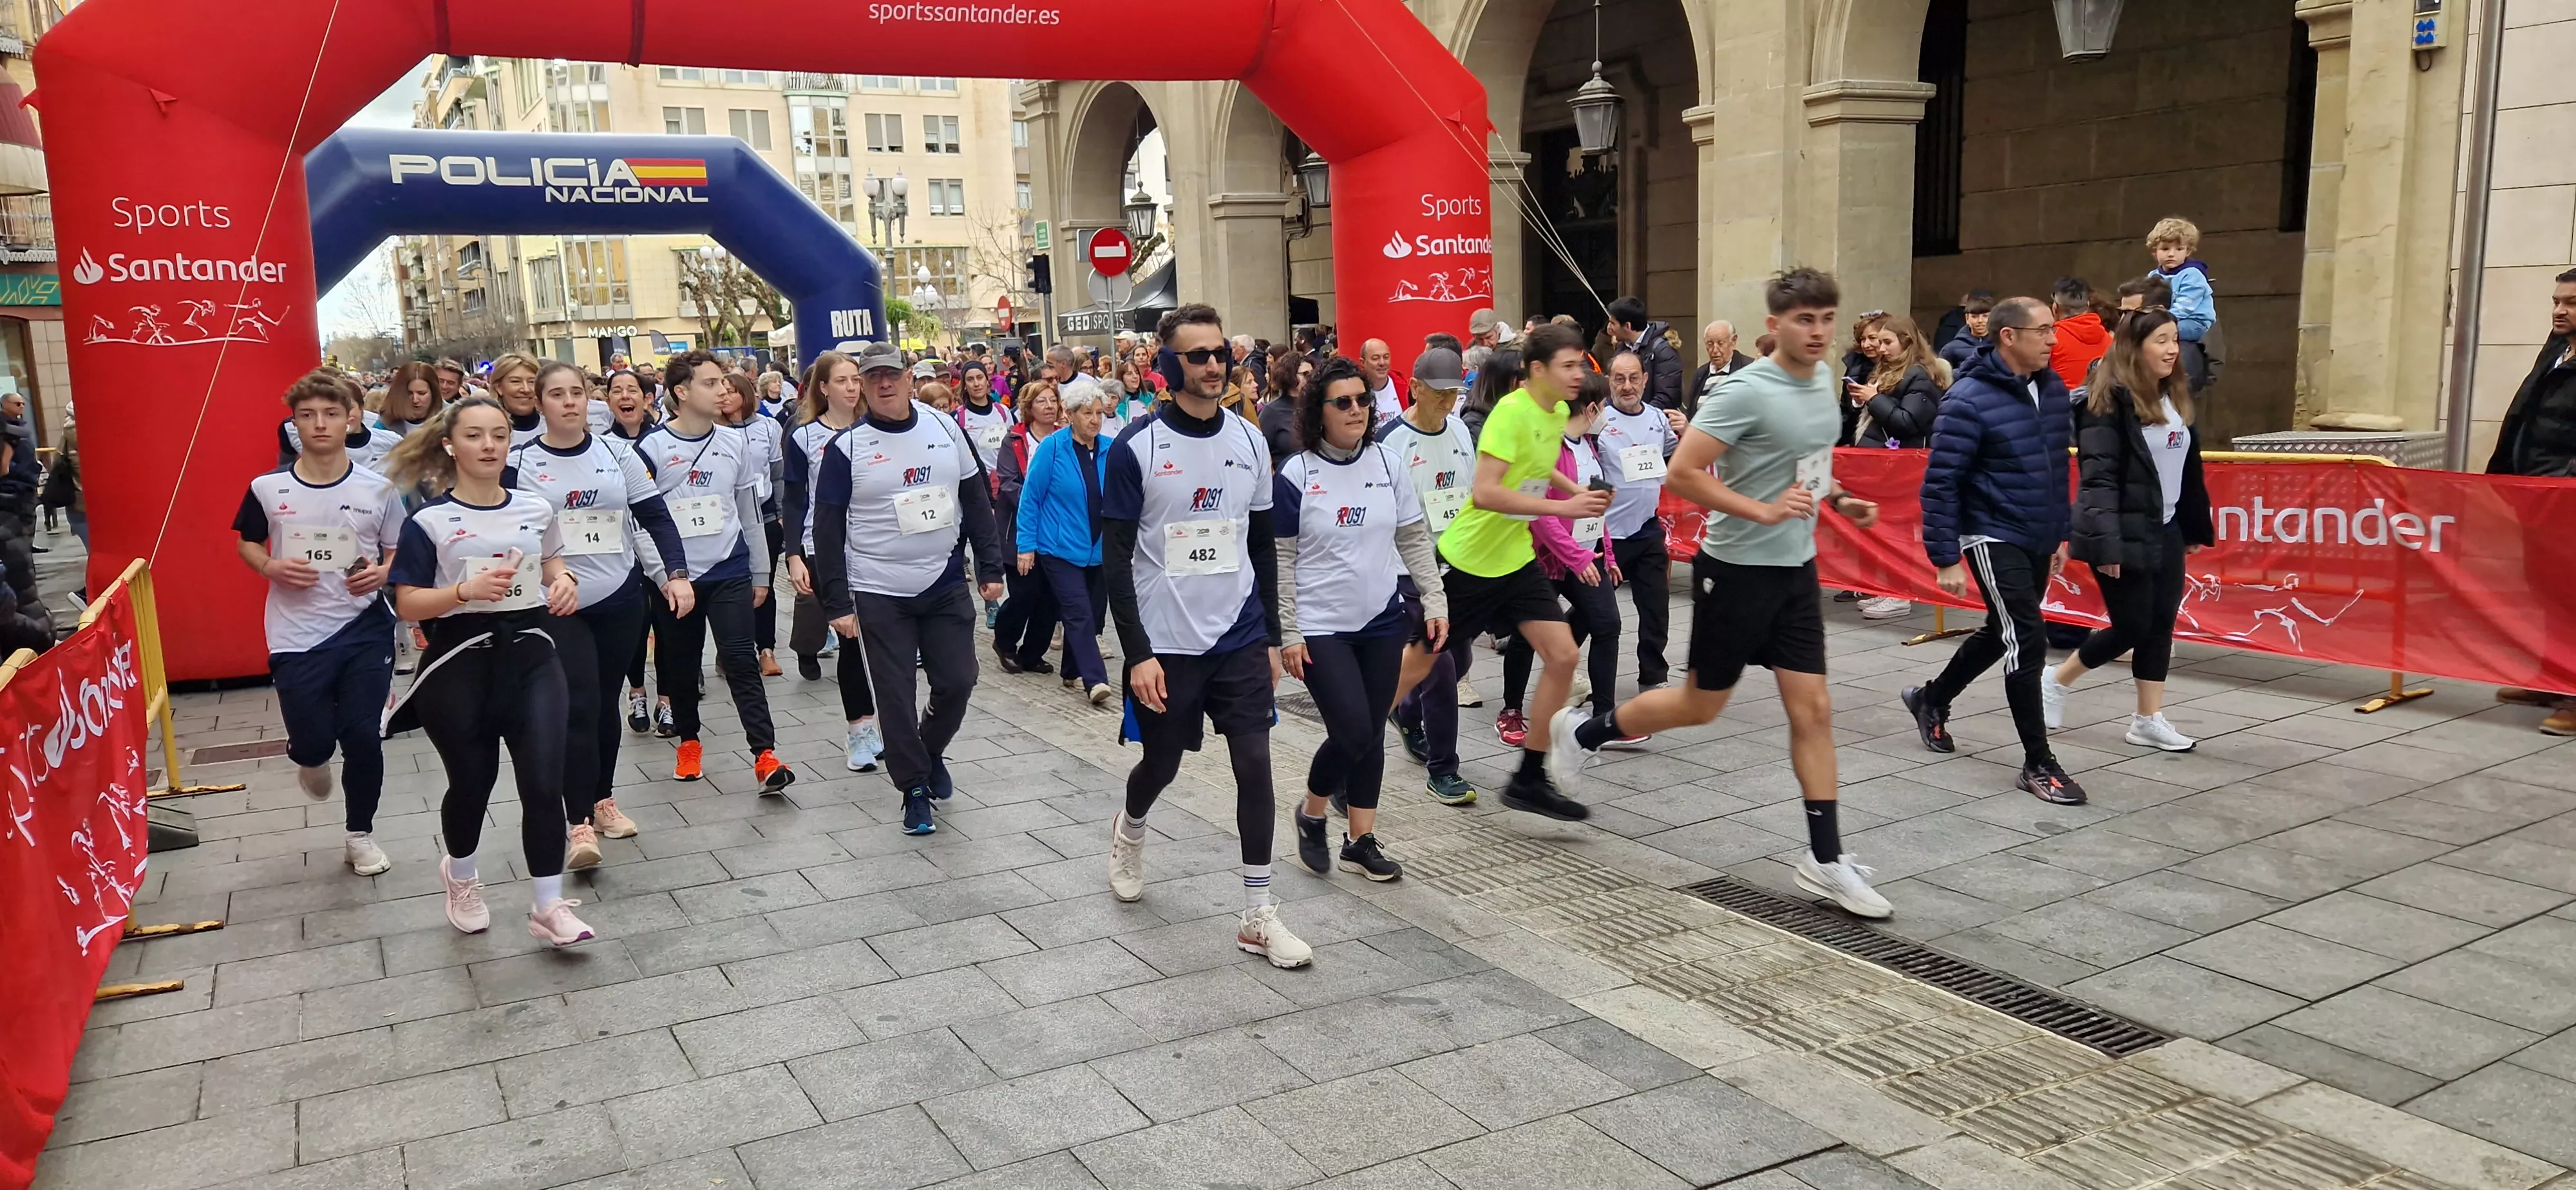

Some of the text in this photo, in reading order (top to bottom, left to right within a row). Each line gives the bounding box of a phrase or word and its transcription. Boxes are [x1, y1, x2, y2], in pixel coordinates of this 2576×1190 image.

[869, 2, 1060, 24] sportssantander.es
[545, 186, 708, 203] NACIONAL
[111, 196, 231, 234] Sports
[1421, 193, 1482, 222] Sports
[1416, 233, 1492, 256] Santande
[108, 252, 287, 283] Santander
[830, 308, 874, 338] RUTA
[1094, 312, 1124, 330] SPOTS
[587, 325, 638, 339] MANGO
[1154, 469, 1184, 477] Santander
[1638, 462, 1653, 471] 222
[691, 516, 705, 527] 13
[921, 509, 936, 520] 12
[1586, 522, 1598, 533] 347
[2210, 496, 2456, 553] ntander
[585, 533, 600, 543] 14
[305, 549, 332, 561] 165
[1189, 548, 1217, 562] 482
